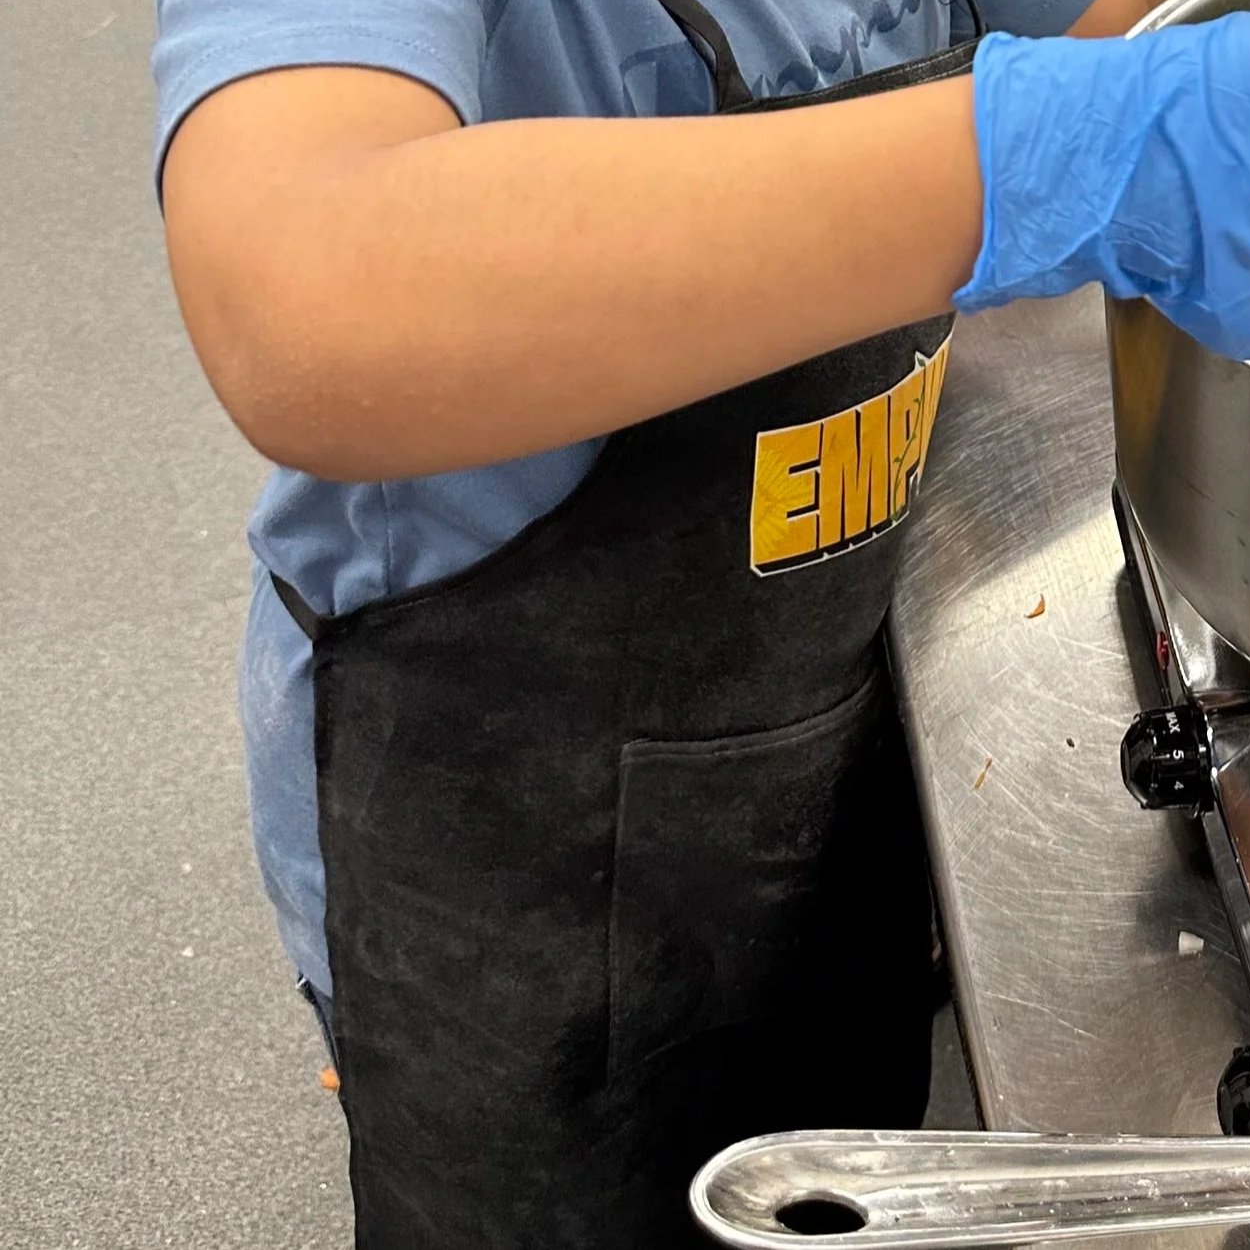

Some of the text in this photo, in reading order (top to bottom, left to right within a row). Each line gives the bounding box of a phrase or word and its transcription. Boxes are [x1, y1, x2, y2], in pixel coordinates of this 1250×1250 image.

[1164, 711, 1181, 734] MAX
[1172, 749, 1185, 761] 5
[1173, 780, 1185, 791] 4
